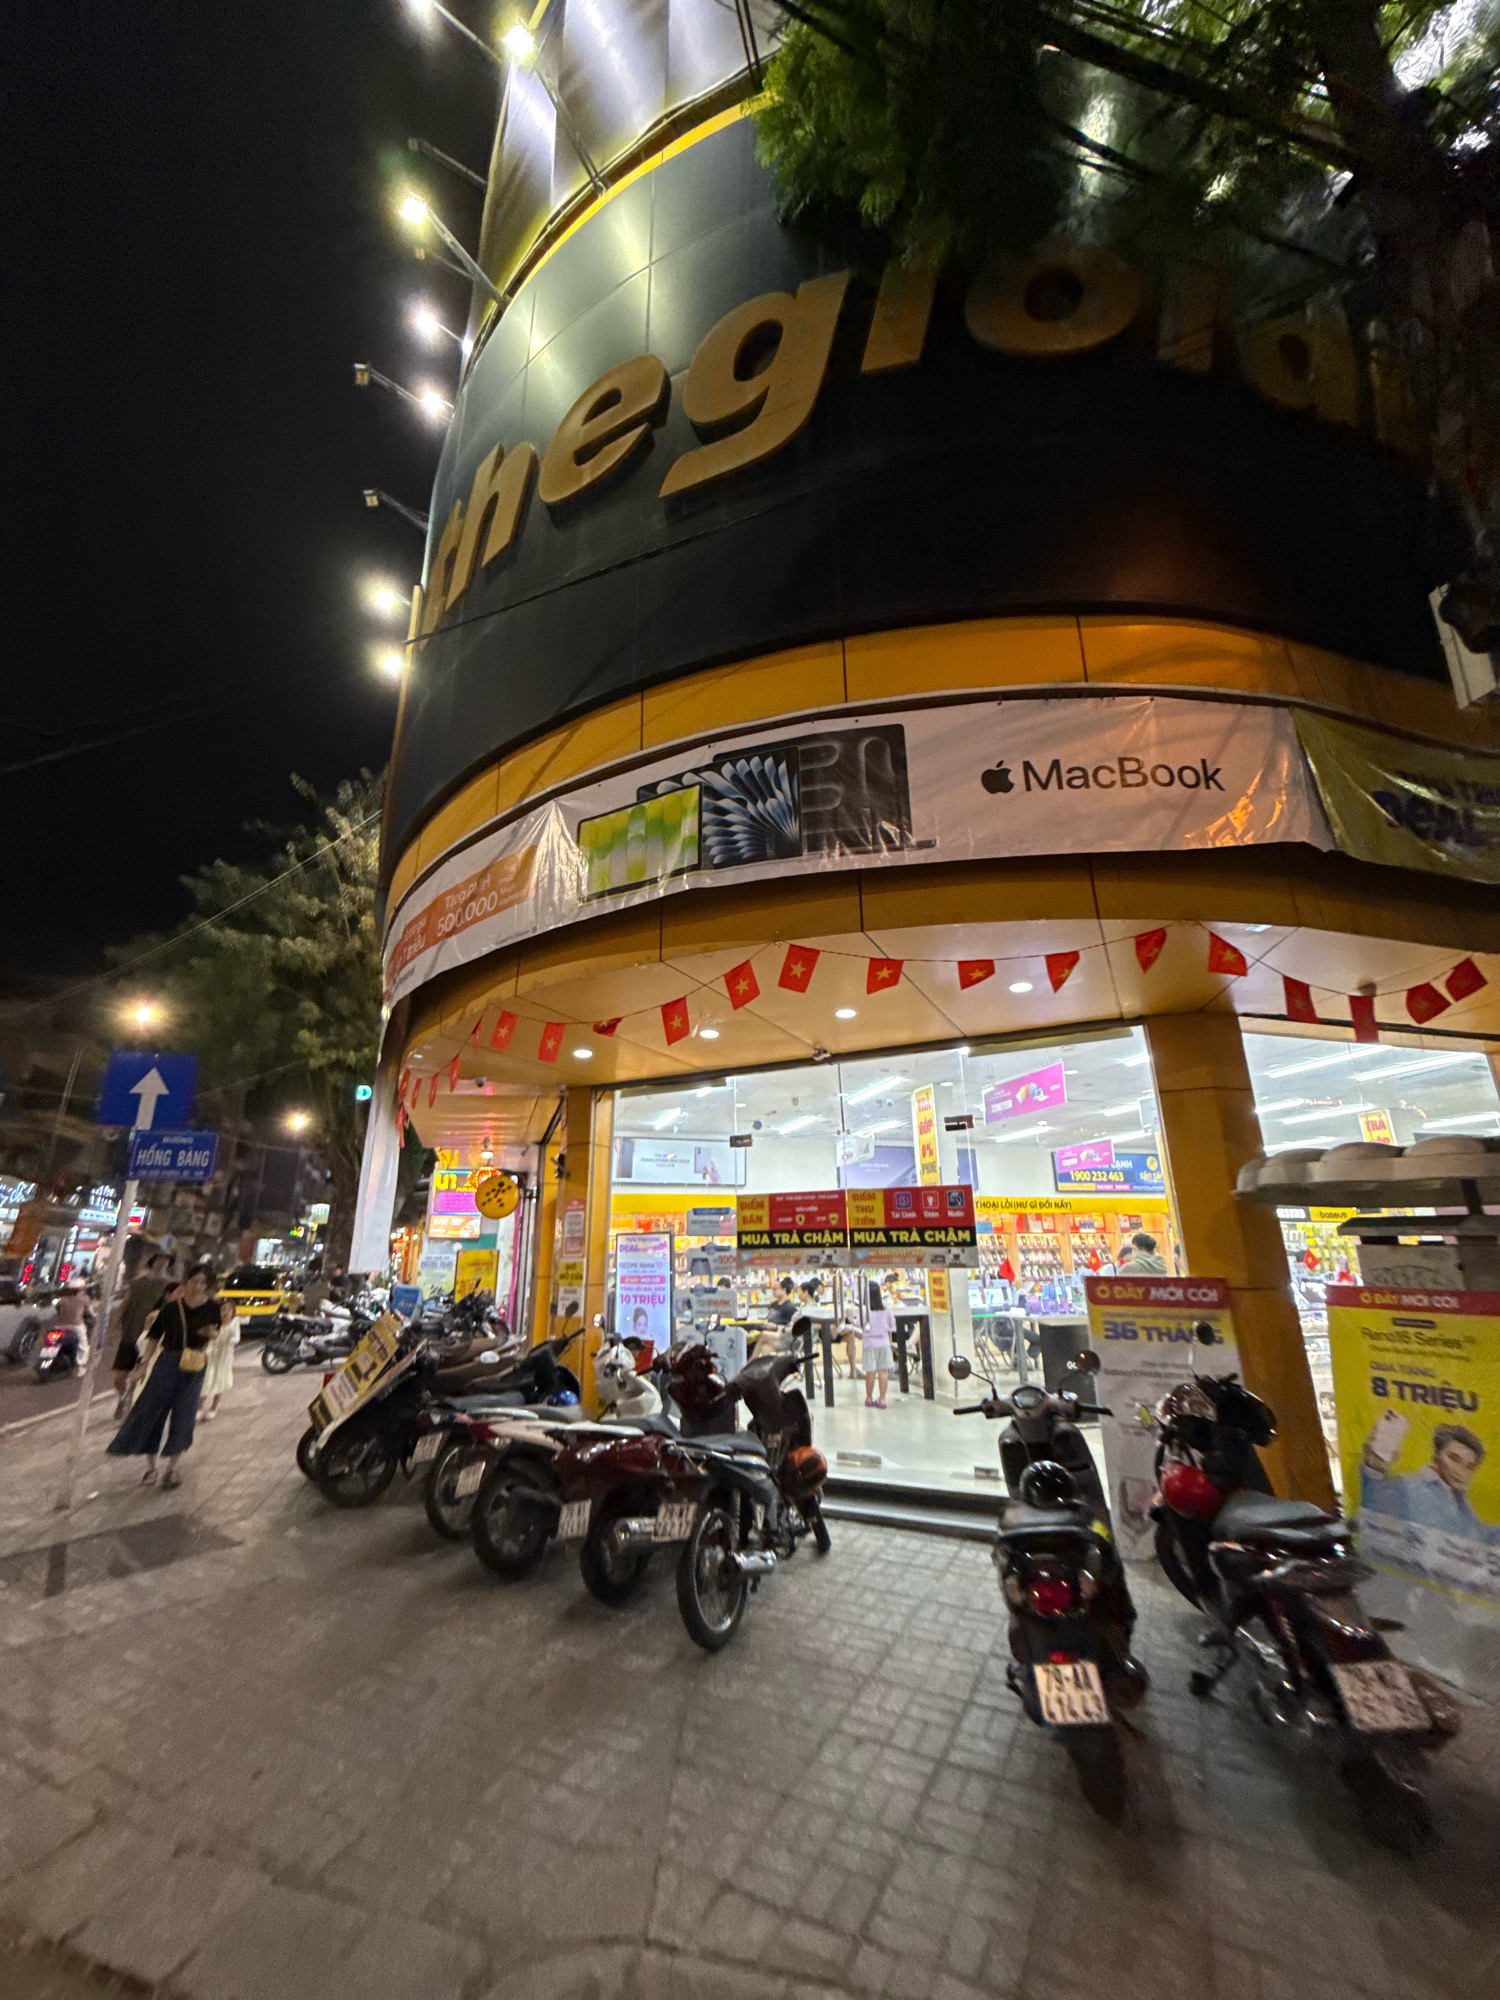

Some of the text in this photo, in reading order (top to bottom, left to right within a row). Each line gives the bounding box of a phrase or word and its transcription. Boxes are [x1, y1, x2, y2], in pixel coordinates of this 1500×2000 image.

[1022, 757, 1225, 793] MacBook
[436, 891, 498, 937] 500.000
[1069, 1170, 1091, 1181] 1900
[1091, 1170, 1108, 1181] 232
[975, 1201, 999, 1211] THOẠI
[1319, 1210, 1348, 1219] baseus
[741, 1229, 844, 1246] MUA TRẢ CHẬM
[853, 1227, 971, 1246] MUA TRẢ CHẬM
[632, 1291, 666, 1307] TRIỆU
[1113, 1284, 1146, 1299] ĐÂY
[1149, 1284, 1185, 1301] MỚI
[1103, 1319, 1139, 1341] 36
[1371, 1376, 1478, 1413] 8 TRIỆU
